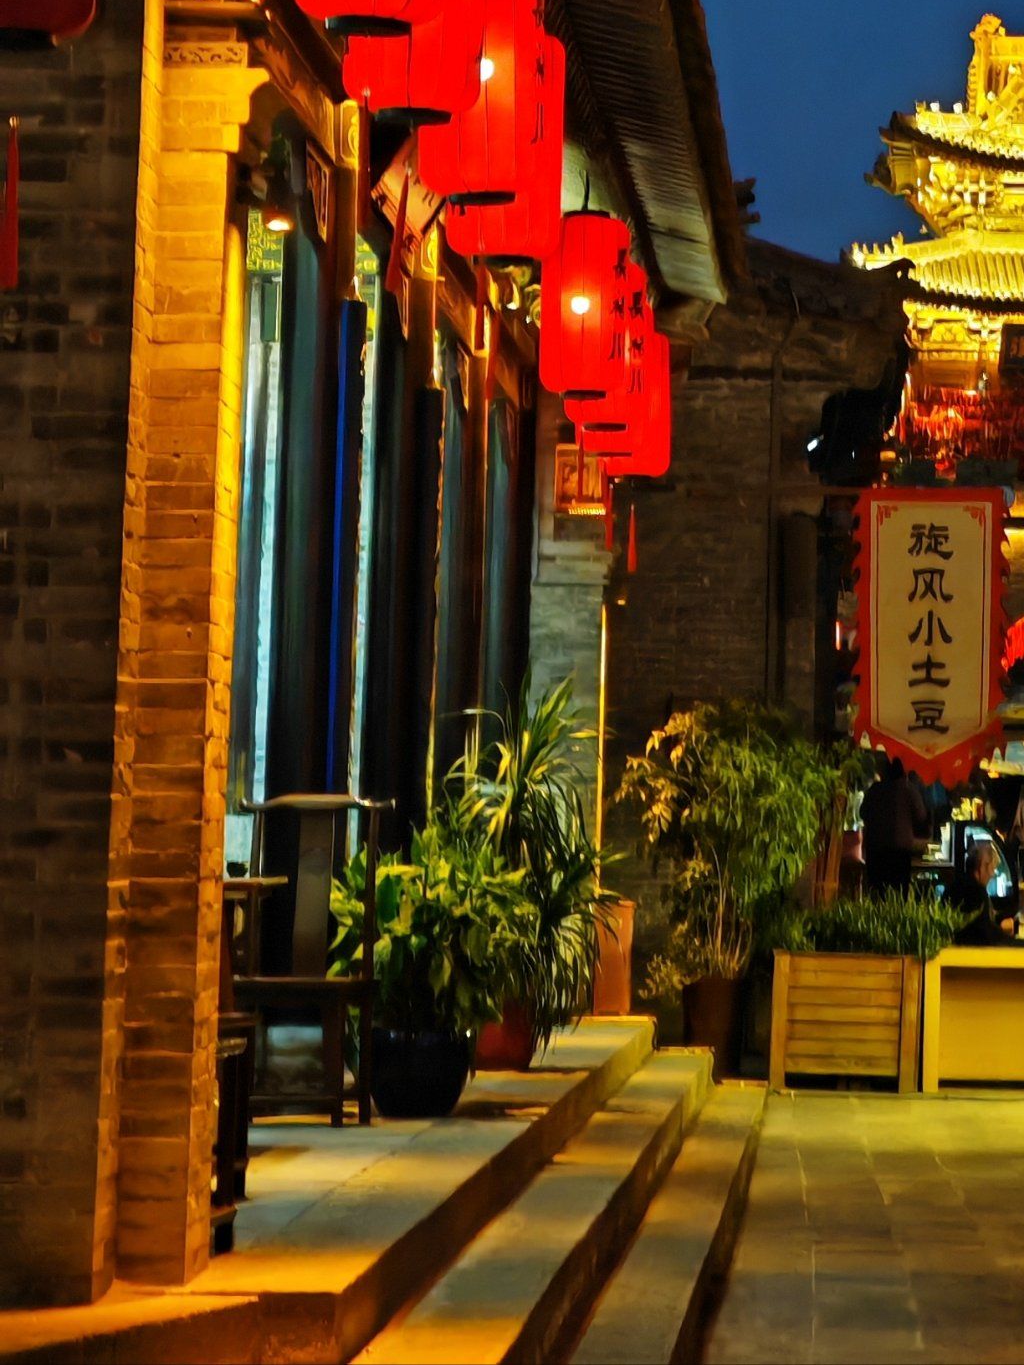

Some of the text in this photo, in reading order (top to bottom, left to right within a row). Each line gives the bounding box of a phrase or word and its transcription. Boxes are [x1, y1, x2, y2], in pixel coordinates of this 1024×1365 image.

[907, 522, 954, 734] 旋风小土豆
